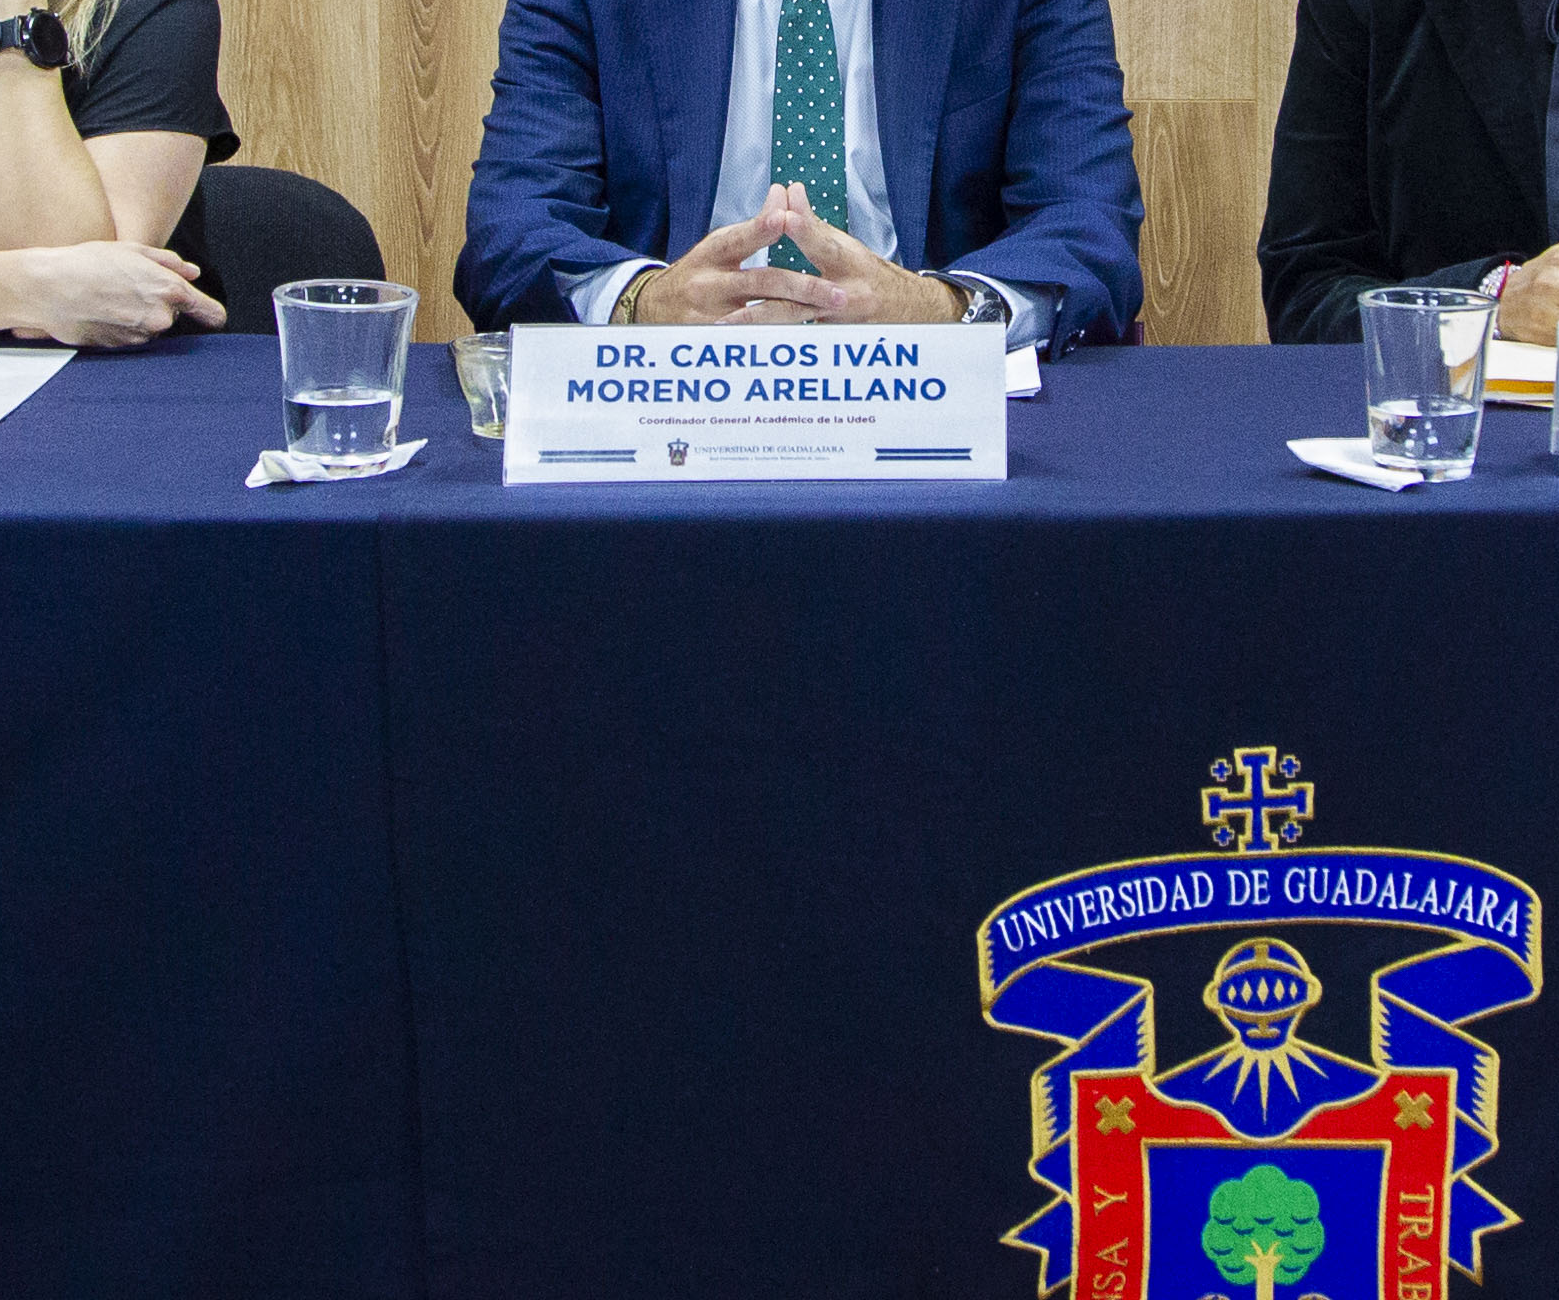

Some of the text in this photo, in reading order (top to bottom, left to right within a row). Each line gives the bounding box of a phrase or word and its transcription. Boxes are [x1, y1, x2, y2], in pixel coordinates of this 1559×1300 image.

[595, 337, 919, 368] DR. CARLOS IVÁN
[567, 377, 947, 402] MORENO ARELLANO
[638, 414, 876, 425] Coordinador General Académico de la UdeG
[694, 444, 846, 454] UNIVERSIDAD DE GUADALAJARA
[996, 866, 1519, 953] UNIVERSIDAD DE GUADALAJARA
[1091, 1183, 1129, 1300] SA Y
